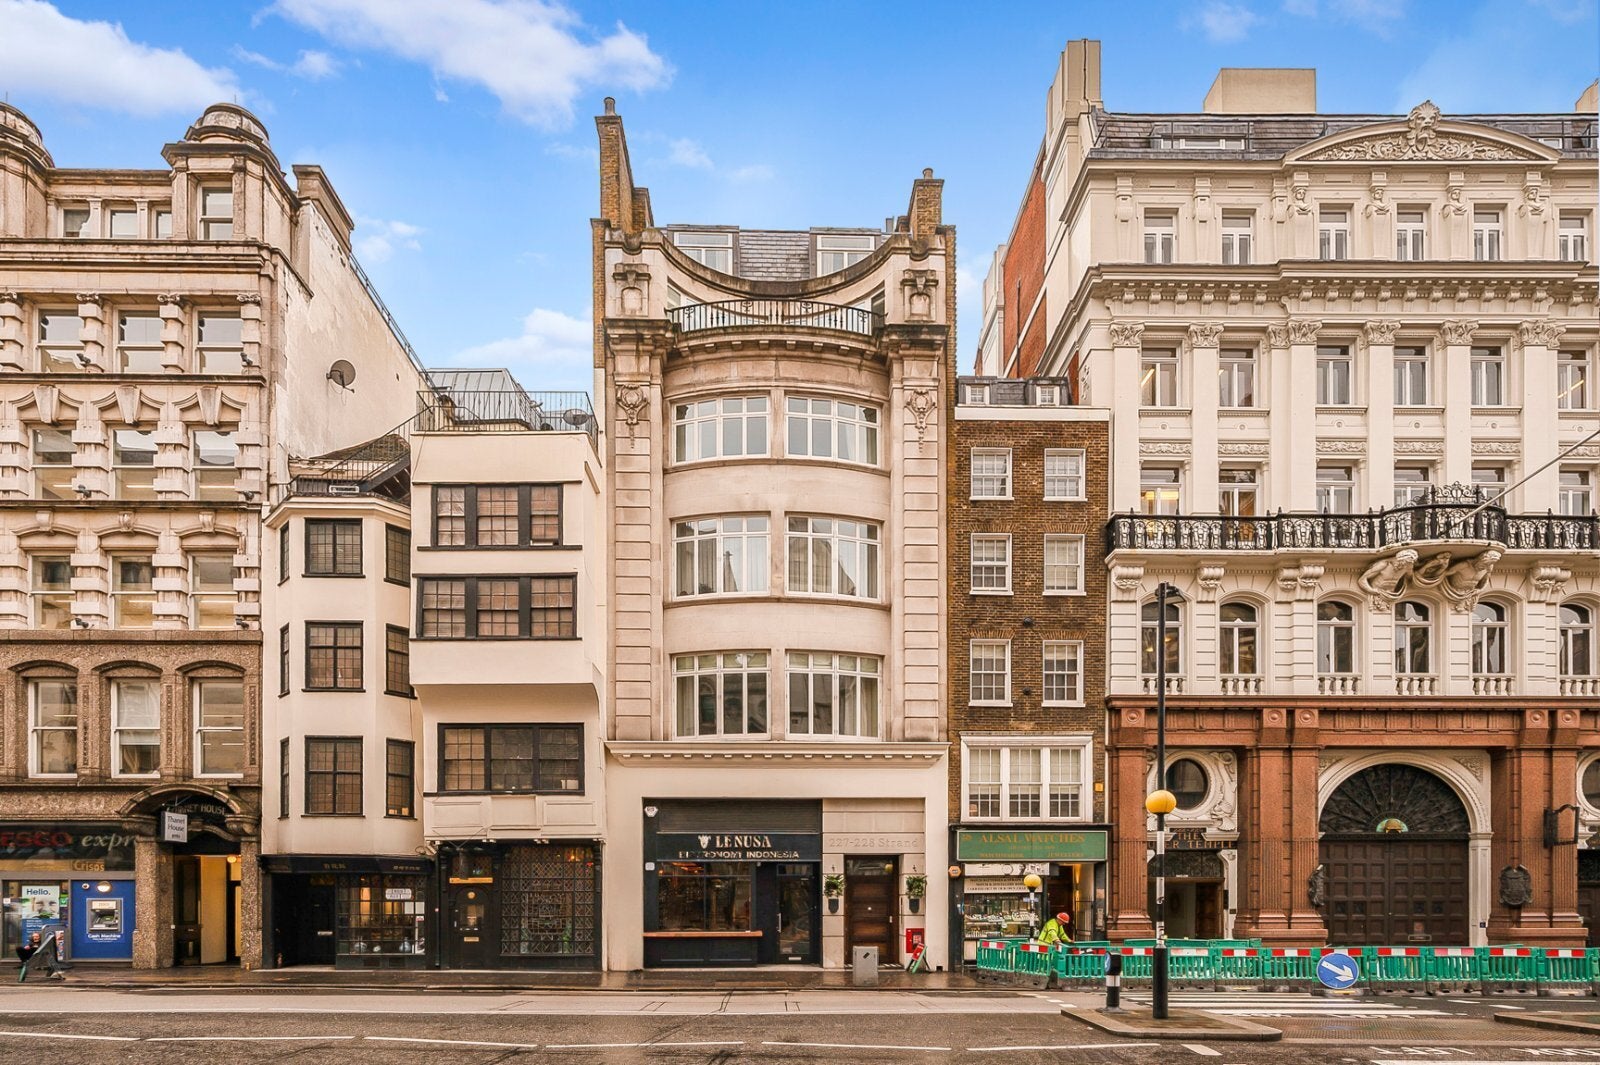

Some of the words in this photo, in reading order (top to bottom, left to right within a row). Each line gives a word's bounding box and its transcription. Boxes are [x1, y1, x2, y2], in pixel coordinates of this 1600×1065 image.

[167, 816, 186, 824] Thanet
[1024, 833, 1085, 843] WATCHES
[1178, 832, 1201, 840] THE
[878, 837, 918, 847] Strand
[26, 888, 51, 896] Hello.
